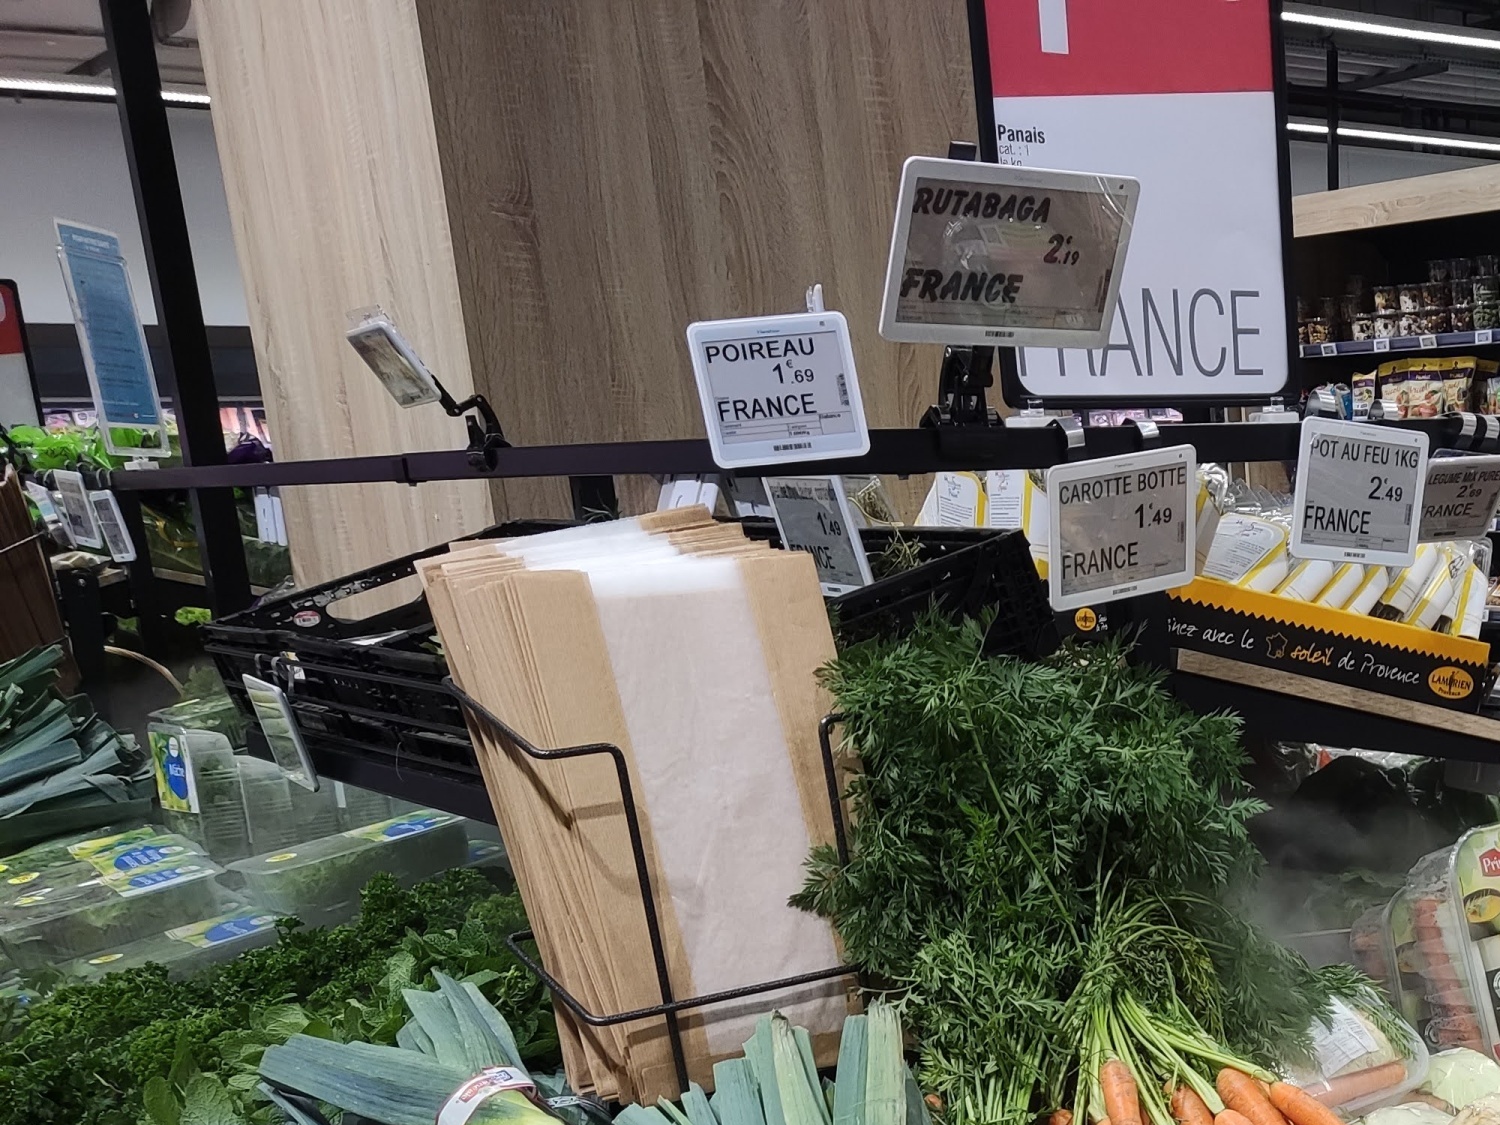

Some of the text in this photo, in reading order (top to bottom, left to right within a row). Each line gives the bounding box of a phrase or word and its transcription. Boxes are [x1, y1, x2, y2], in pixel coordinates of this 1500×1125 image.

[997, 124, 1046, 144] Panais
[912, 187, 1051, 223] RUTABAGA
[900, 268, 1024, 304] FRANCE
[1019, 288, 1264, 376] ANCE
[705, 337, 815, 364] POIREAU
[717, 393, 817, 422] FRANCE
[1311, 439, 1418, 469] POT AU FEU 1KG
[1059, 475, 1132, 505] CAROTTE
[1138, 466, 1186, 492] BOTTE
[1428, 472, 1462, 485] LEGUME
[1303, 505, 1371, 535] FRANCE
[1423, 503, 1474, 518] RANCE
[1062, 542, 1139, 580] FRANCE
[1167, 618, 1420, 685] inez avec le soleil de Provence
